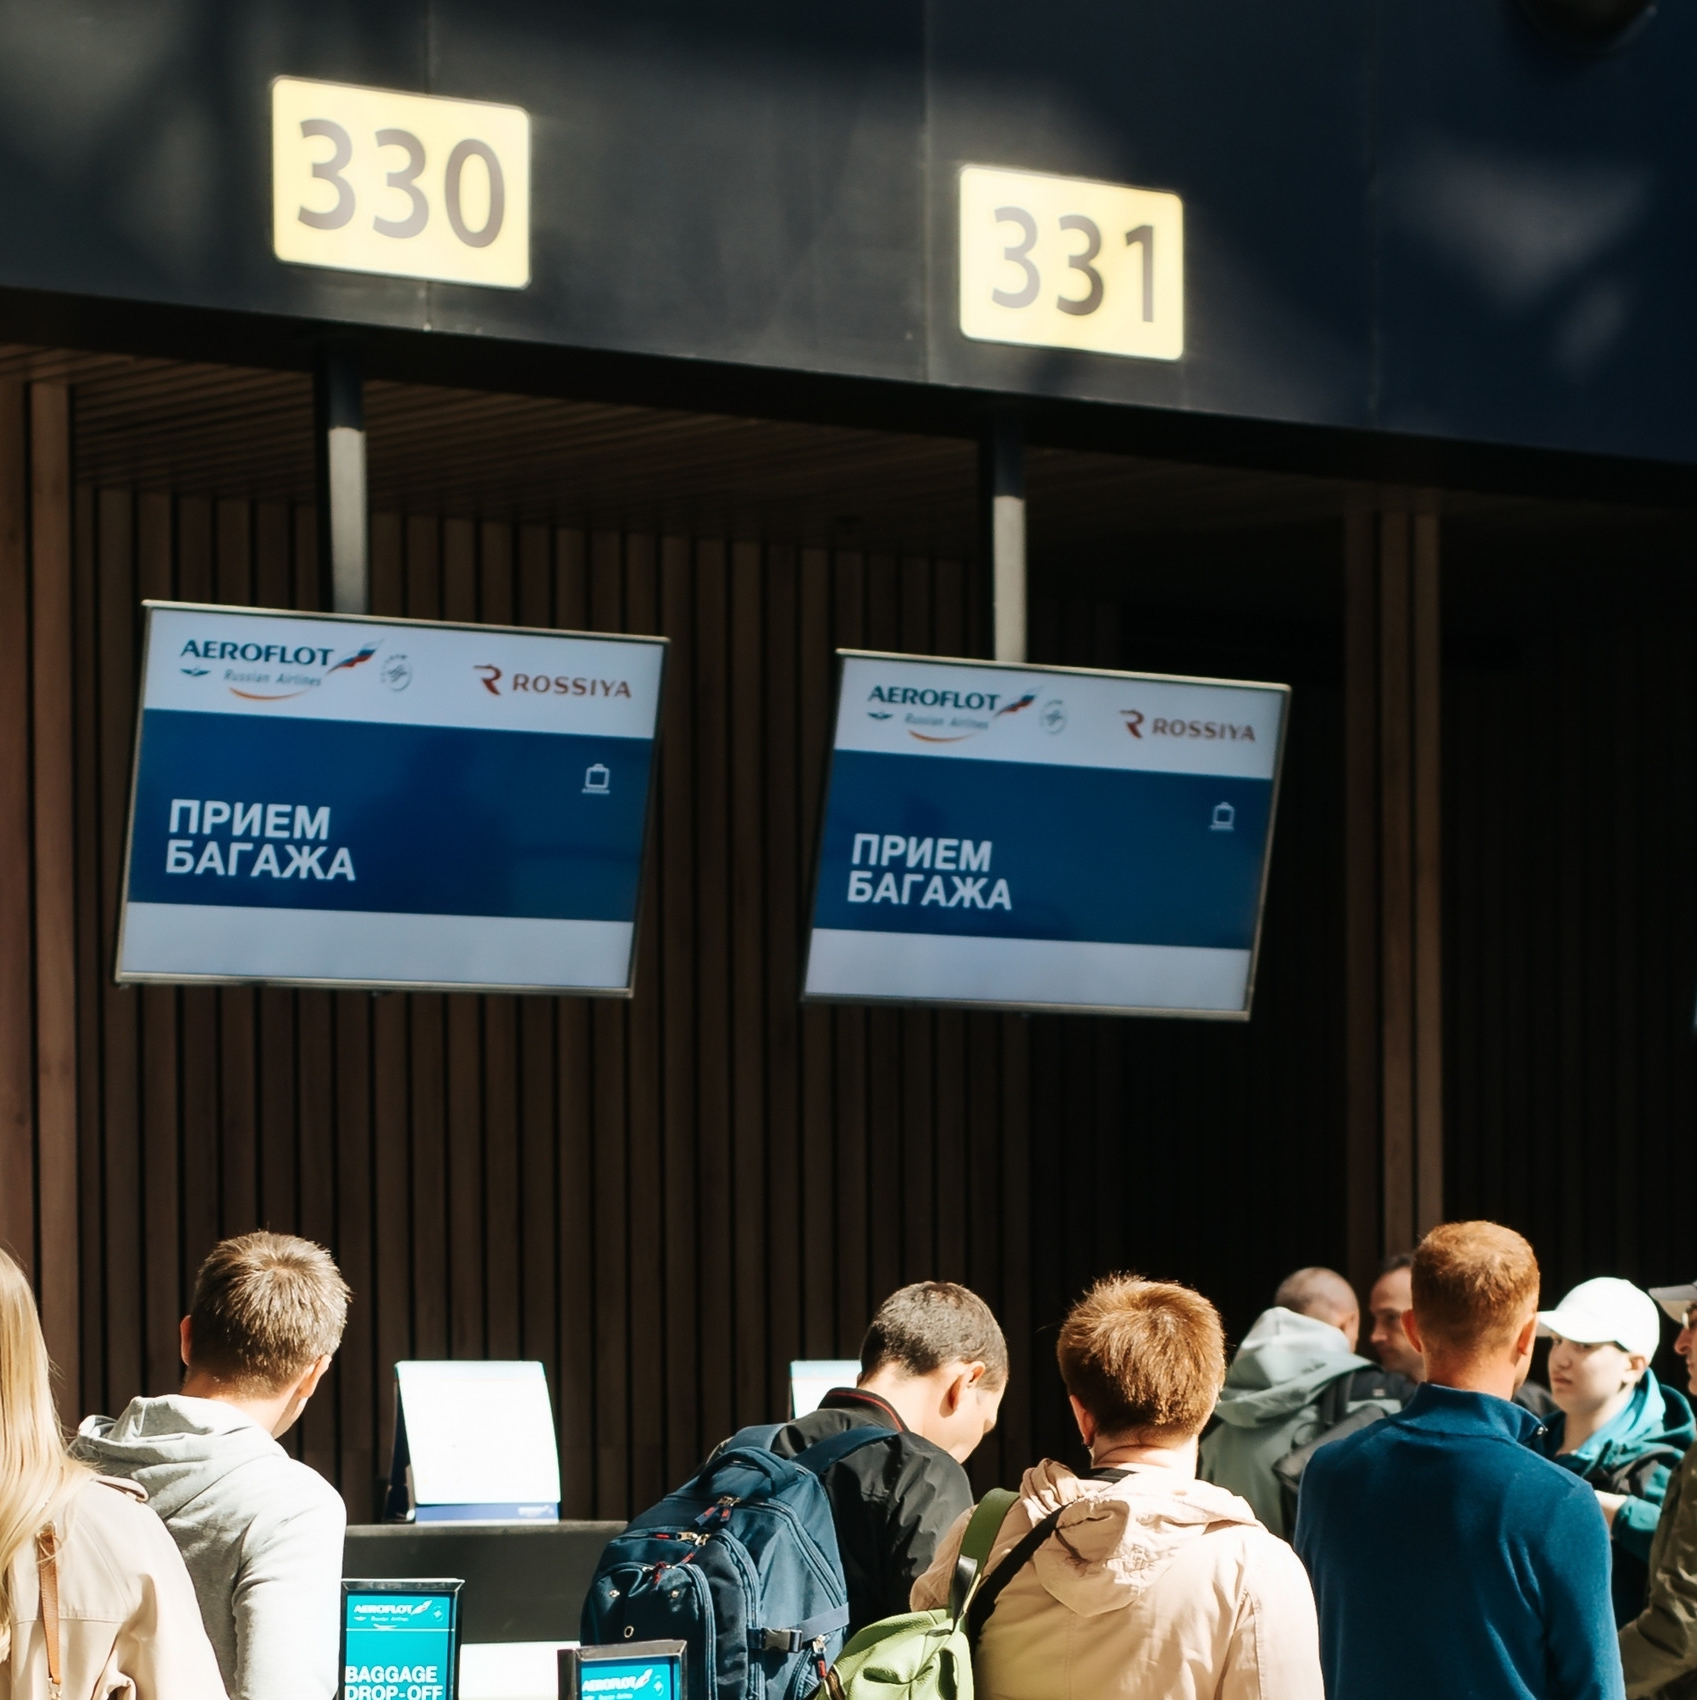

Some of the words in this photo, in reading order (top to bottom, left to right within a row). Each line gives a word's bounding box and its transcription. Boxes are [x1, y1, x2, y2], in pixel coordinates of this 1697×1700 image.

[296, 118, 505, 249] 330
[988, 206, 1157, 324] 331
[180, 639, 335, 668] AEROFLOT
[512, 672, 633, 699] ROSSIYA
[867, 685, 1001, 712] AEROFLOT
[1152, 718, 1256, 743] ROSSIYA
[168, 799, 331, 840] ПРИЕМ
[165, 839, 356, 882] БАГАЖА
[851, 833, 993, 872] ПРИЕМ
[847, 871, 1013, 911] БАГАЖА
[344, 1666, 438, 1683] BAGGAGE
